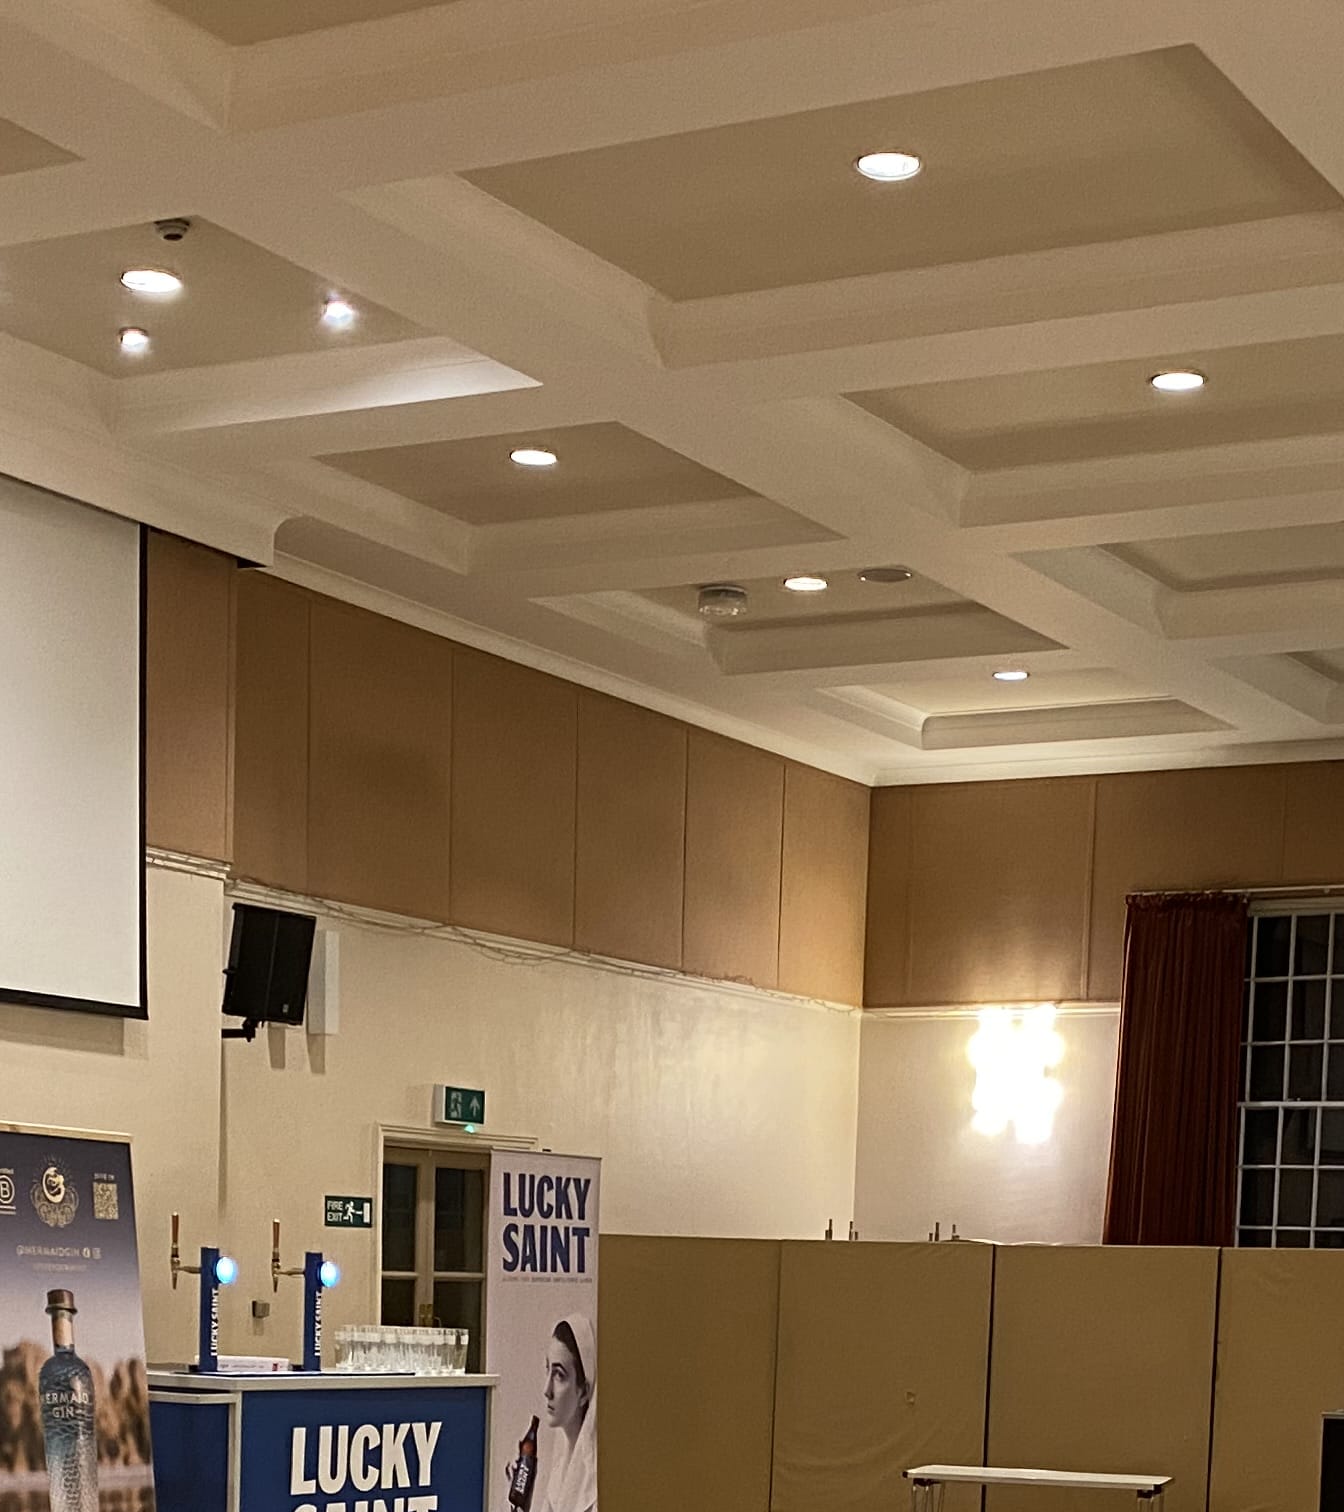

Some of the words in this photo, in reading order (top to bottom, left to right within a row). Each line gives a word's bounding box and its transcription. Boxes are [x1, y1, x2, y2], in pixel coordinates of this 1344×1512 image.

[327, 1200, 343, 1210] FIRE
[327, 1212, 343, 1222] EXIT
[503, 1172, 591, 1221] LUCKY
[502, 1223, 591, 1274] SAINT
[289, 1421, 442, 1496] LUCKY
